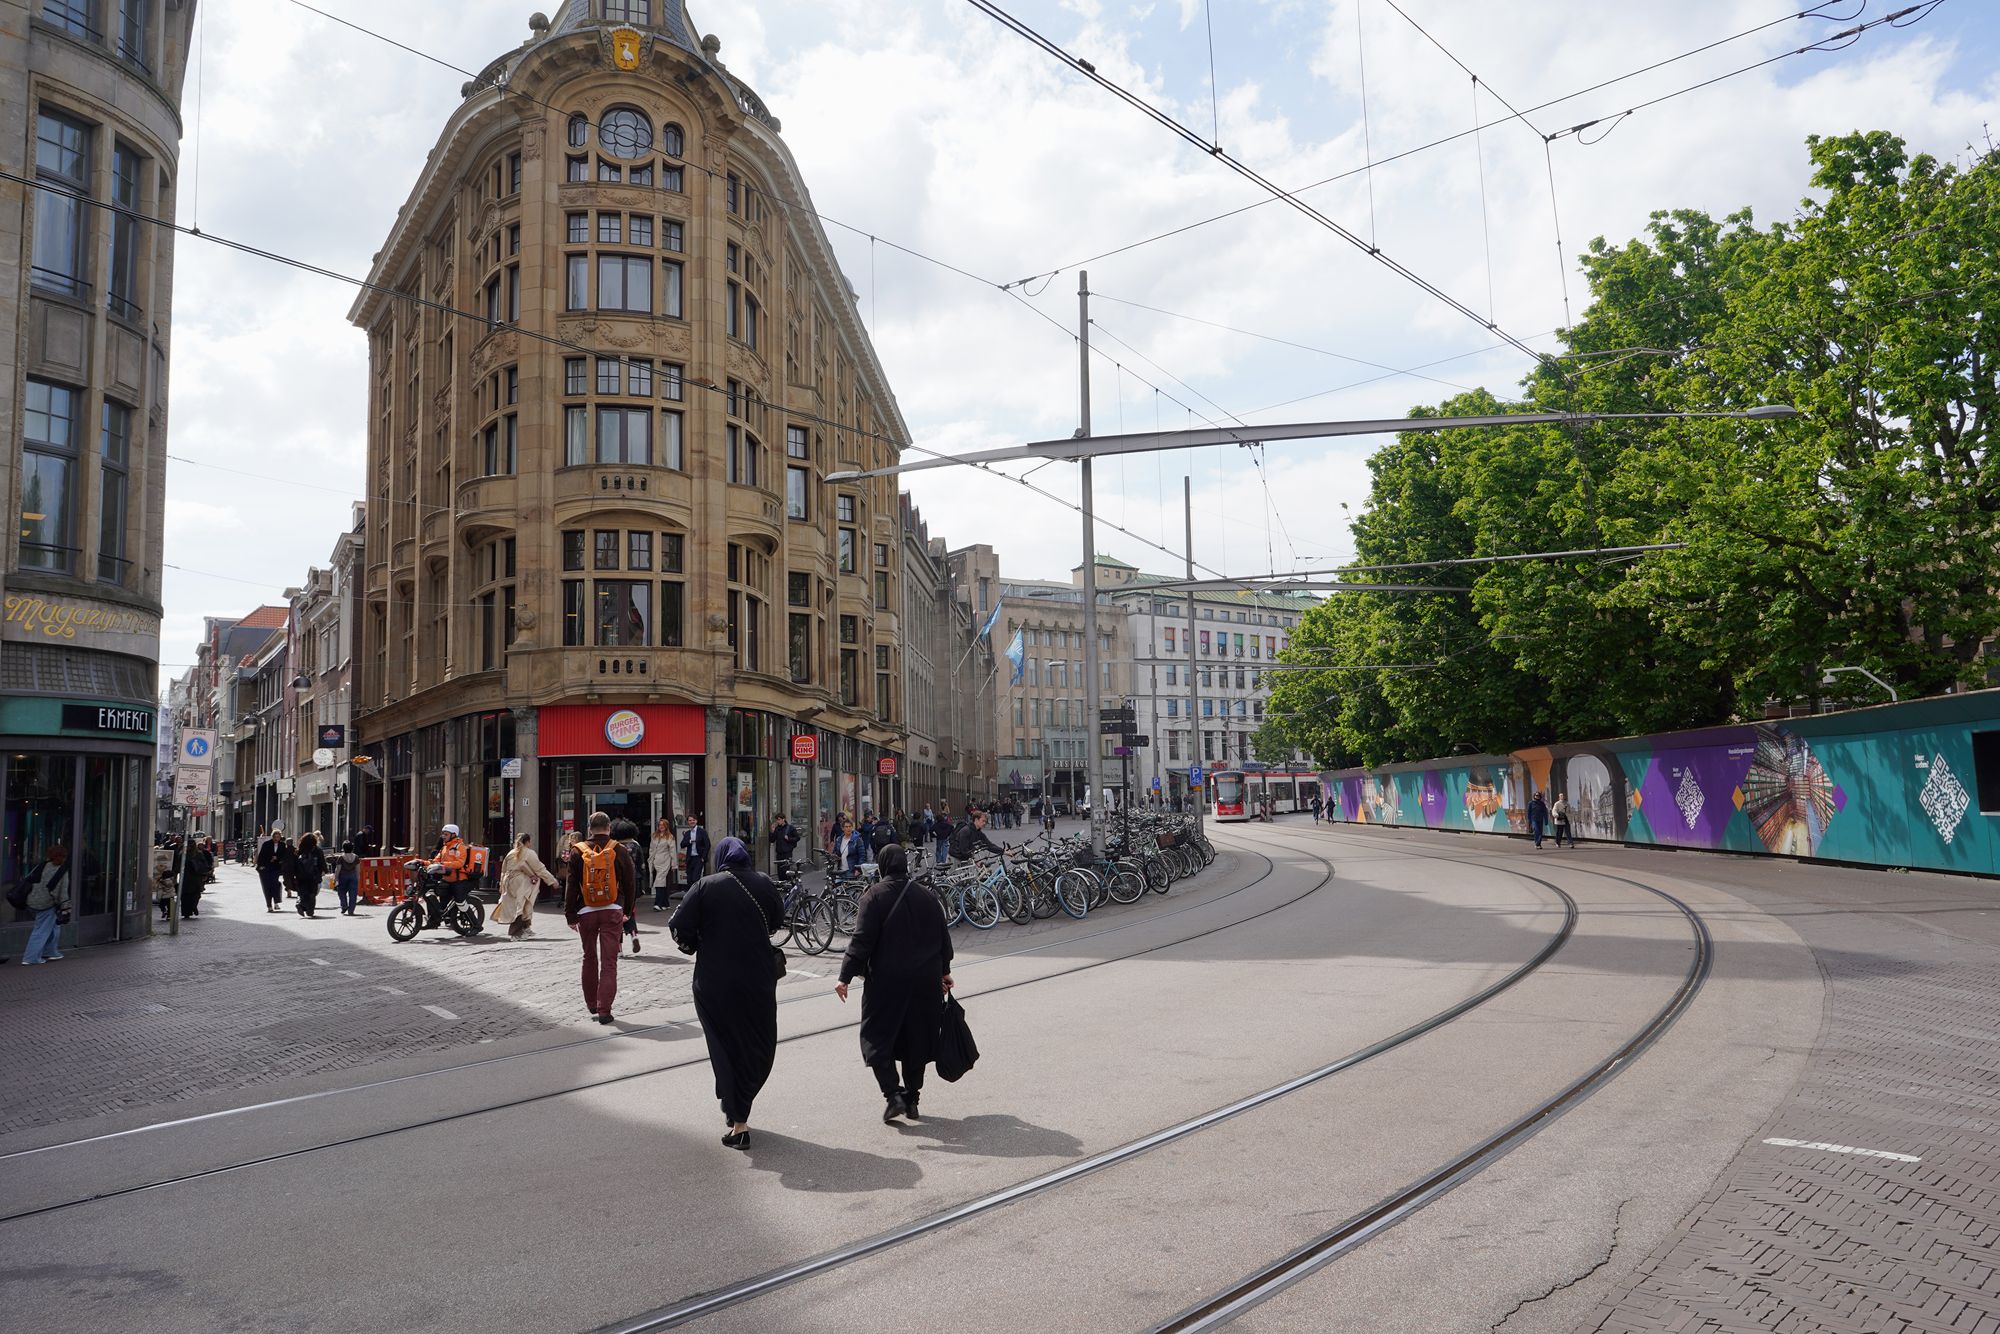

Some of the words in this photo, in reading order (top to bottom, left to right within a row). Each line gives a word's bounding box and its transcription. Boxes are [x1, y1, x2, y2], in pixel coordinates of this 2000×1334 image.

[99, 708, 148, 731] EKMEKCI
[610, 716, 639, 731] BURGER
[612, 723, 640, 738] KING
[1192, 768, 1199, 777] P
